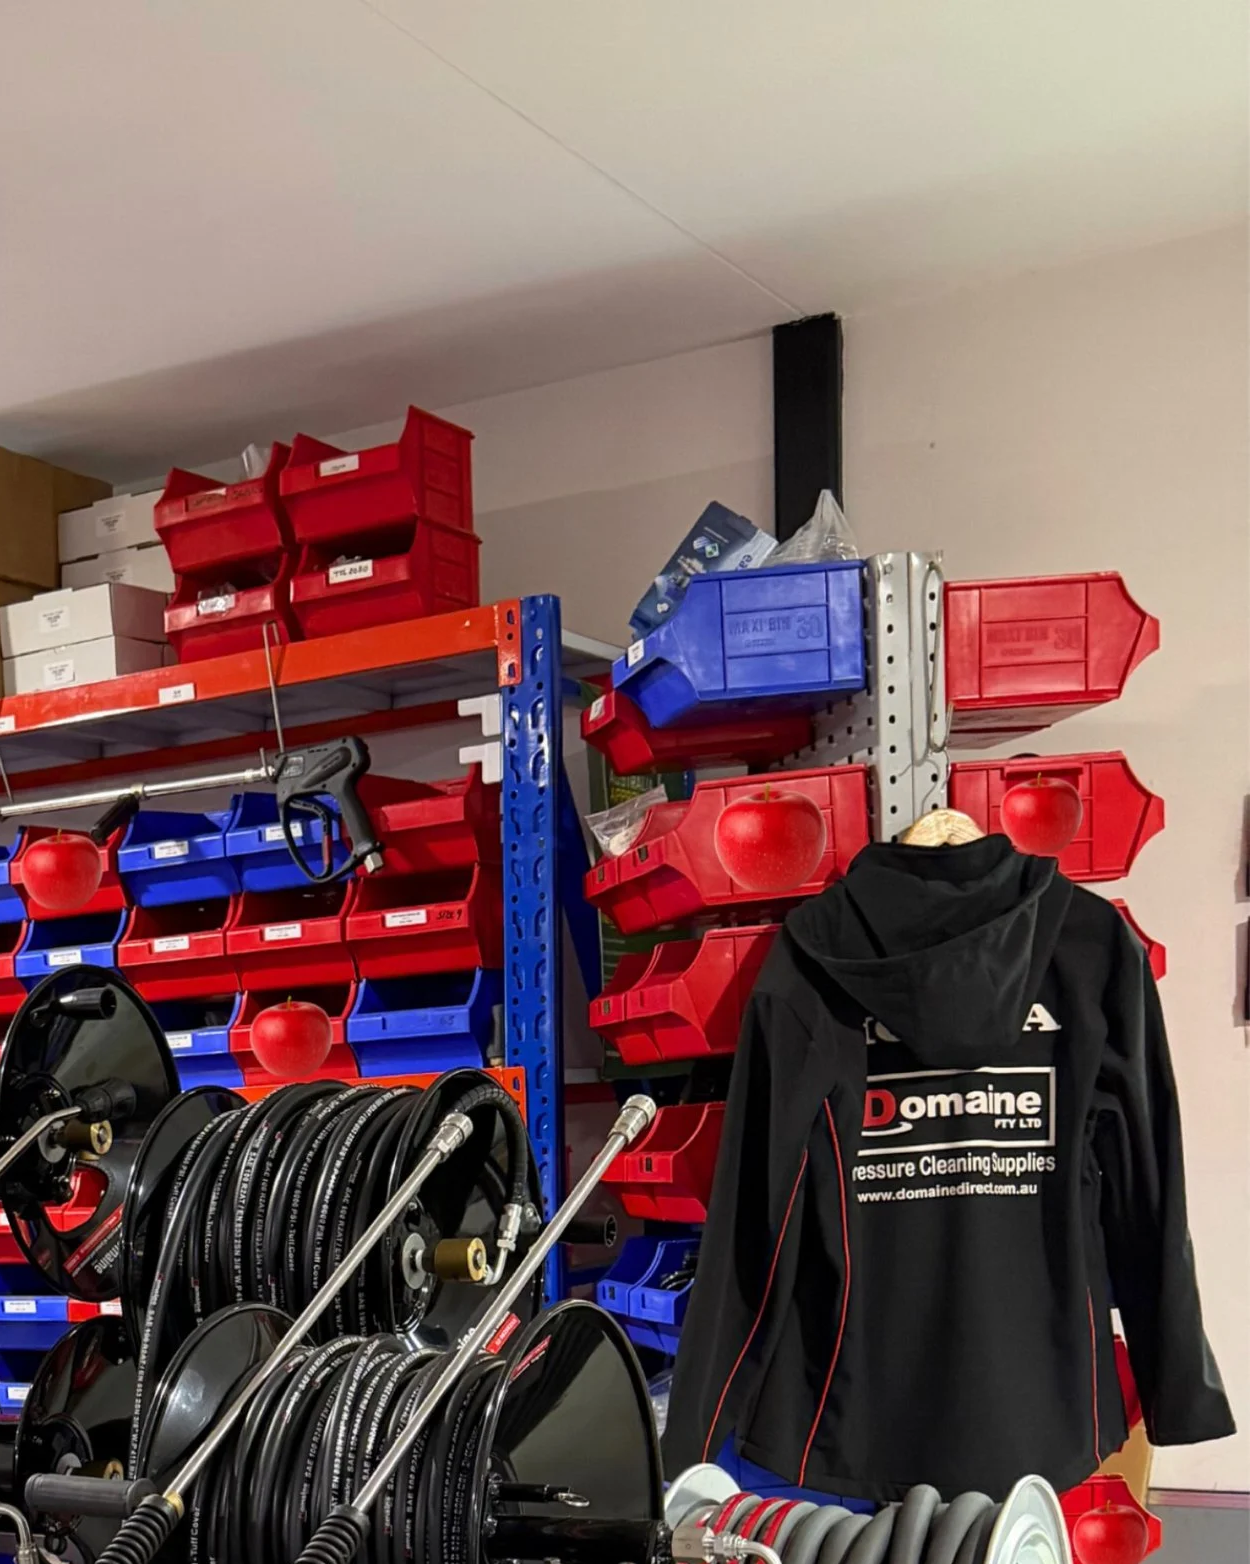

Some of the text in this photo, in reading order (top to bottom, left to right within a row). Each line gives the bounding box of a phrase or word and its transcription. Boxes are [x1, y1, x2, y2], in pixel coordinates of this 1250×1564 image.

[796, 615, 823, 640] 30
[862, 1084, 1042, 1128] Domaine
[994, 1117, 1042, 1129] PTY LTD
[852, 1152, 1056, 1182] ressure Cleaning Supplies
[190, 1507, 200, 1536] Cover
